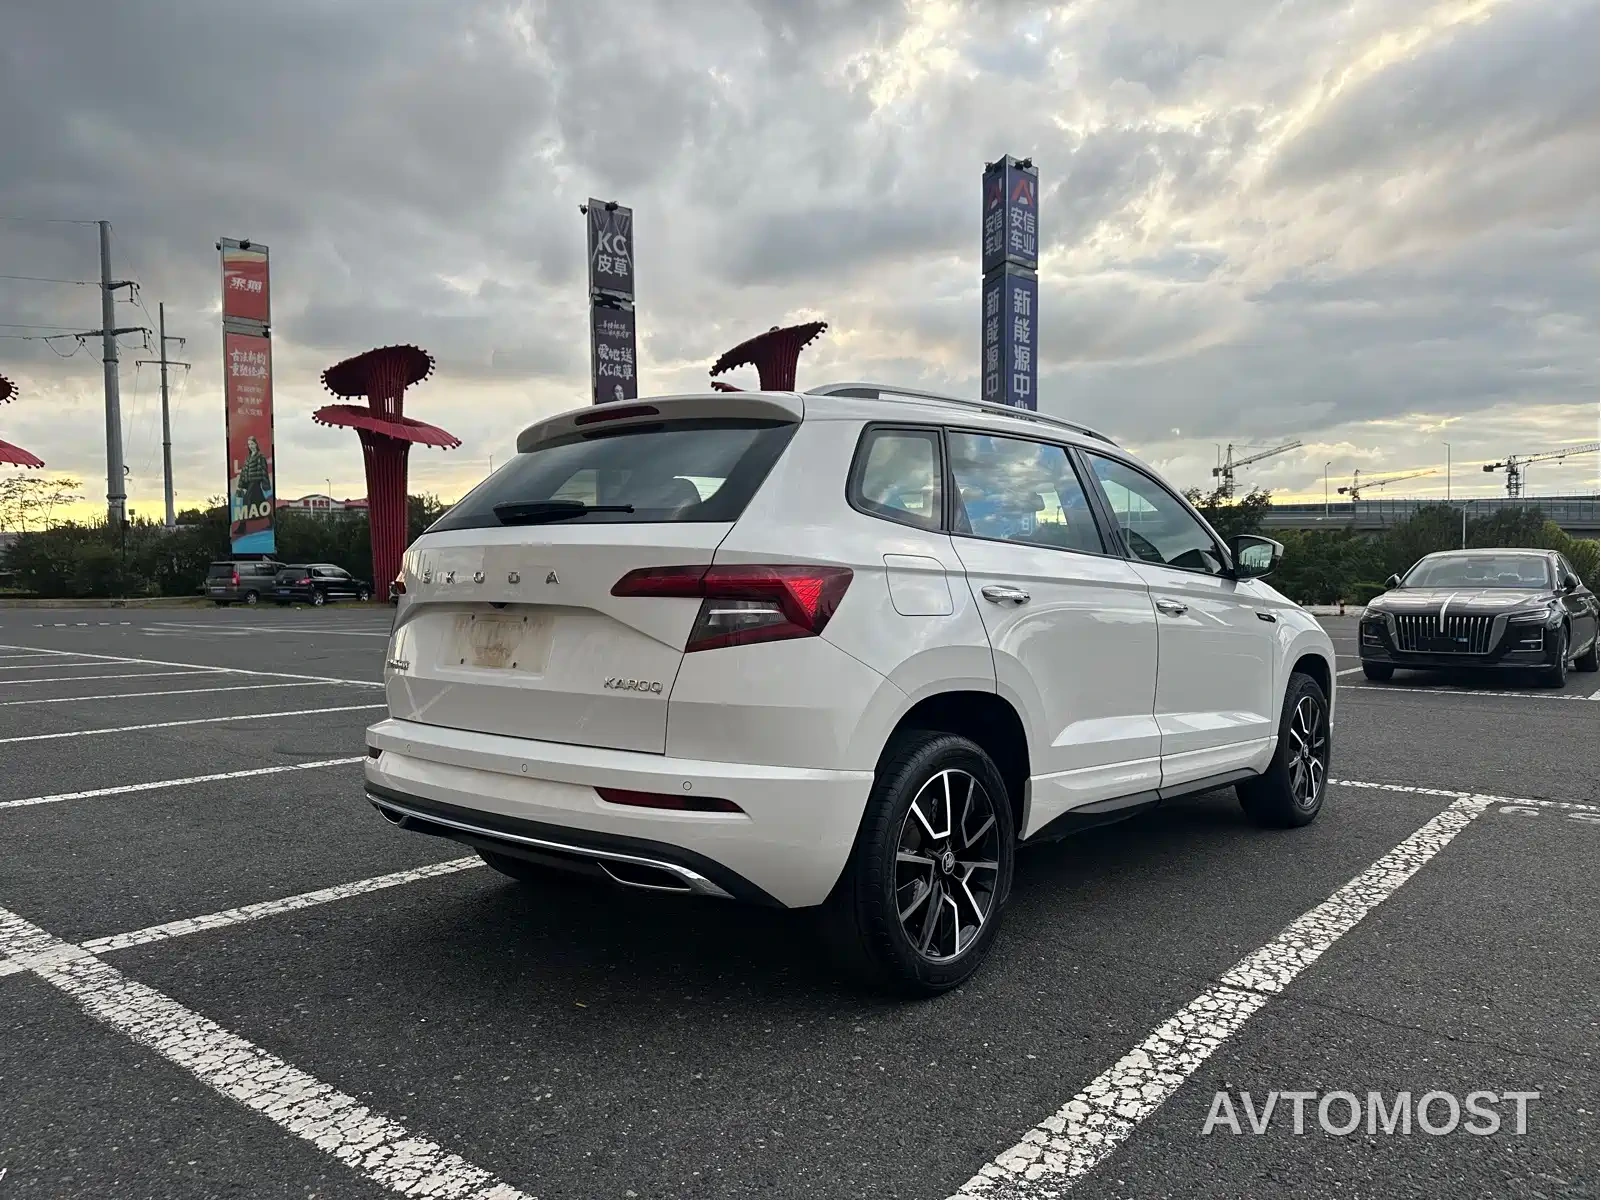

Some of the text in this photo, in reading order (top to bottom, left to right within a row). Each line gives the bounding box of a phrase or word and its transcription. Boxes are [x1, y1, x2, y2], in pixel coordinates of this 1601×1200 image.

[986, 208, 1003, 237] 安信
[1011, 207, 1036, 233] 安信
[598, 230, 627, 256] KC
[1010, 229, 1035, 256] 车业
[597, 253, 628, 278] 皮草
[233, 501, 272, 521] MAO
[603, 676, 664, 696] KAROQ
